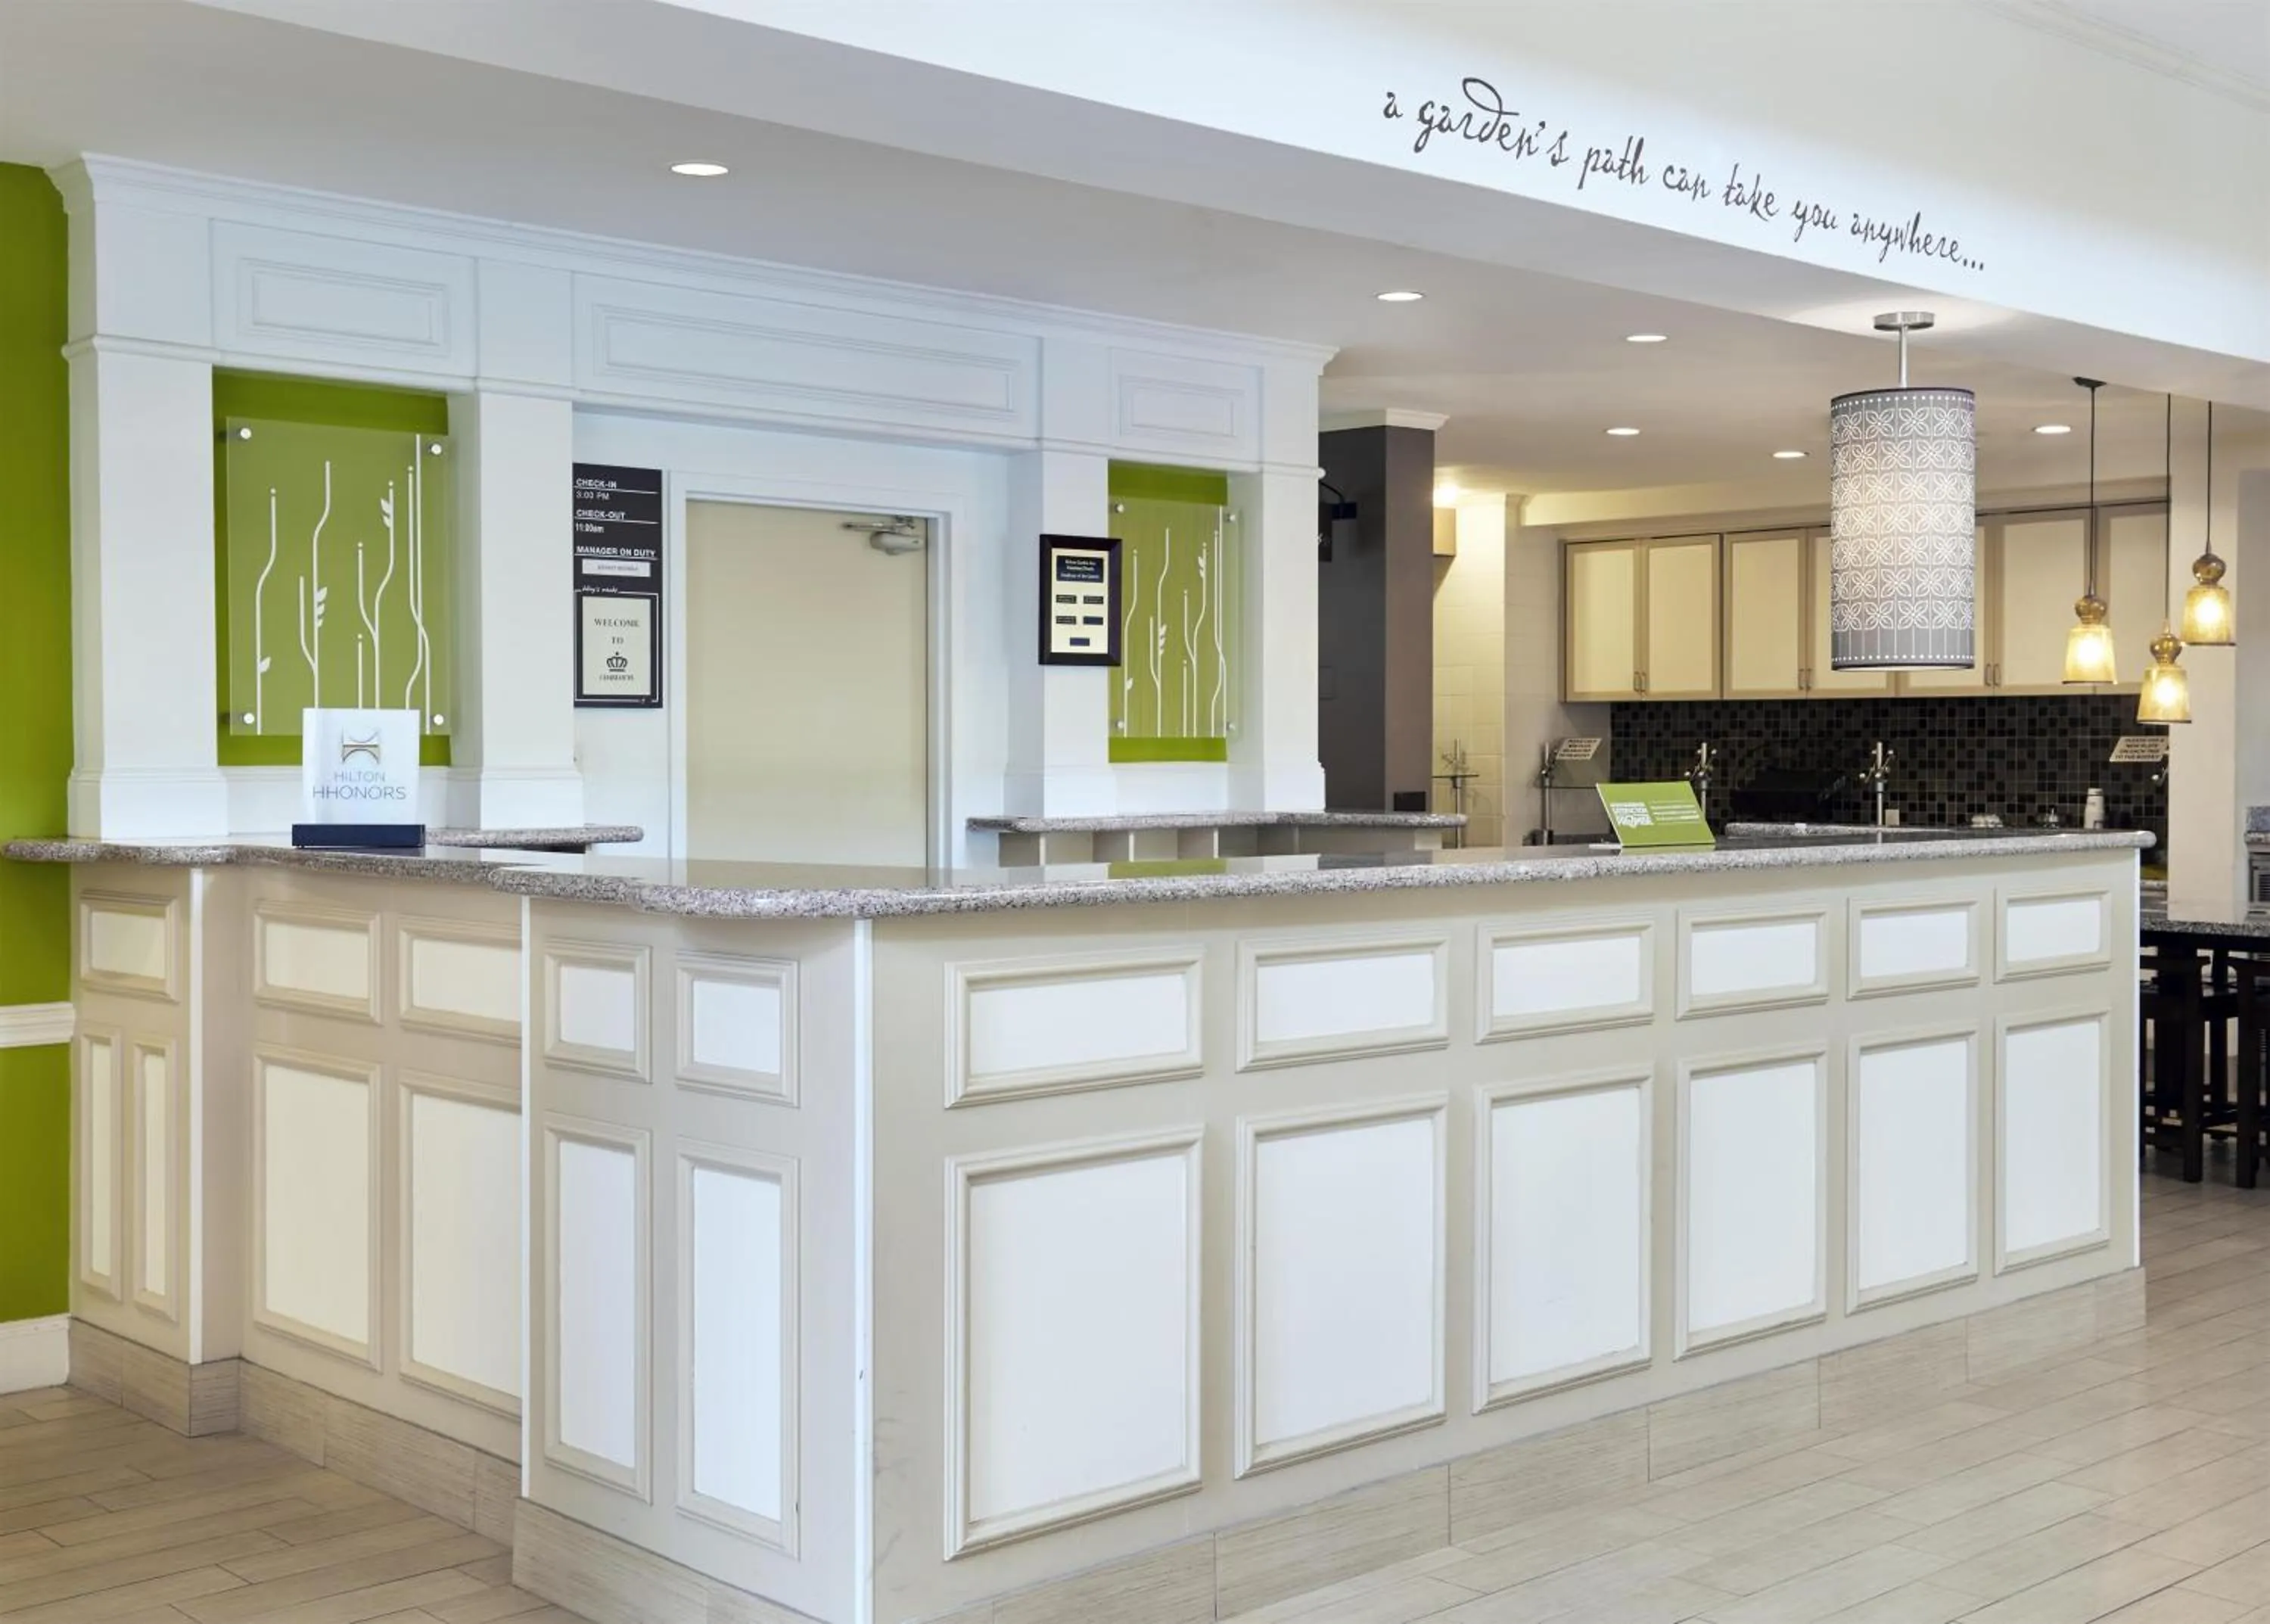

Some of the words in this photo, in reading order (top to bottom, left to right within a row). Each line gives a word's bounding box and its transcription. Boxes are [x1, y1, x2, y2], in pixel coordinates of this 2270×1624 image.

[1383, 92, 1403, 119] a
[1413, 77, 1569, 166] garden's
[1578, 135, 1649, 190] path
[1662, 164, 1711, 201] can
[1722, 163, 1779, 222] take
[1790, 201, 1839, 243] you
[1850, 211, 1985, 271] anywhere...
[576, 478, 617, 489] CHECK-IN
[576, 509, 626, 520] CHECK-OUT
[576, 546, 618, 555] MANAGER
[620, 548, 632, 556] ON
[633, 549, 656, 558] DUTY
[334, 770, 387, 783] HILTON
[313, 786, 407, 800] HHONORS
